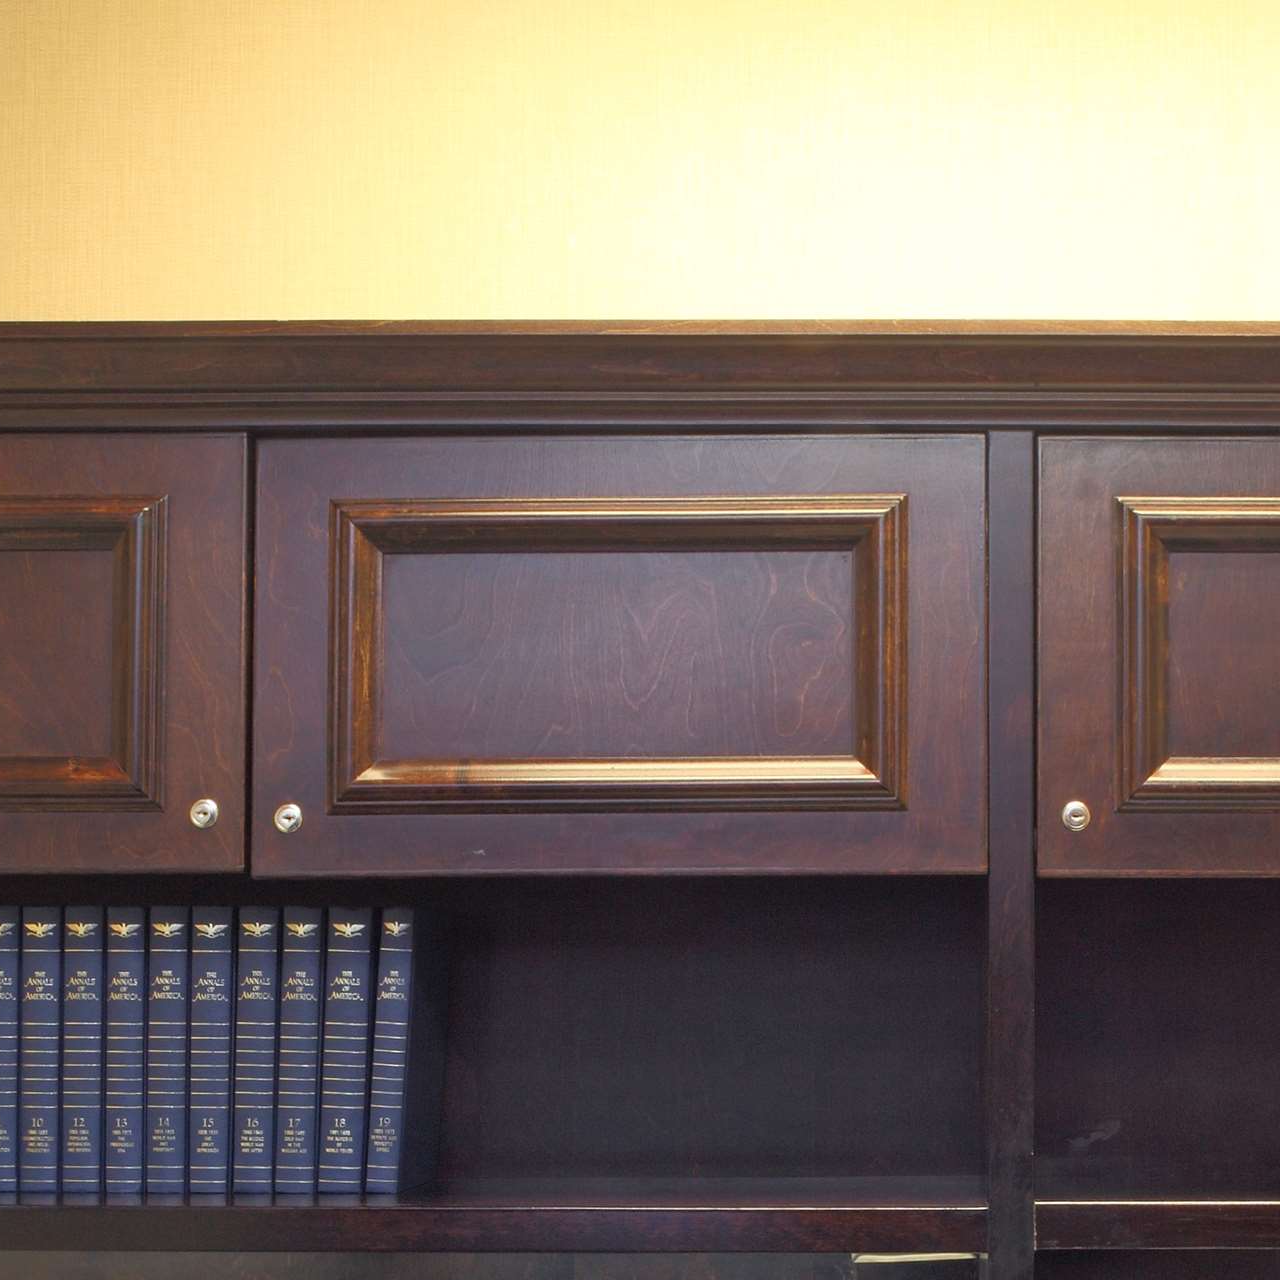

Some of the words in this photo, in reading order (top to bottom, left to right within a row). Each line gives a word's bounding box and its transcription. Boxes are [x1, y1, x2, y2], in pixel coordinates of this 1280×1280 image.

[31, 1118, 44, 1128] 10
[73, 1118, 86, 1127] 12
[115, 1118, 128, 1128] 13
[158, 1117, 170, 1127] 14
[202, 1118, 215, 1128] 15
[247, 1118, 260, 1128] 16
[288, 1118, 301, 1128] 17
[334, 1118, 347, 1128] 18
[379, 1117, 392, 1127] 19
